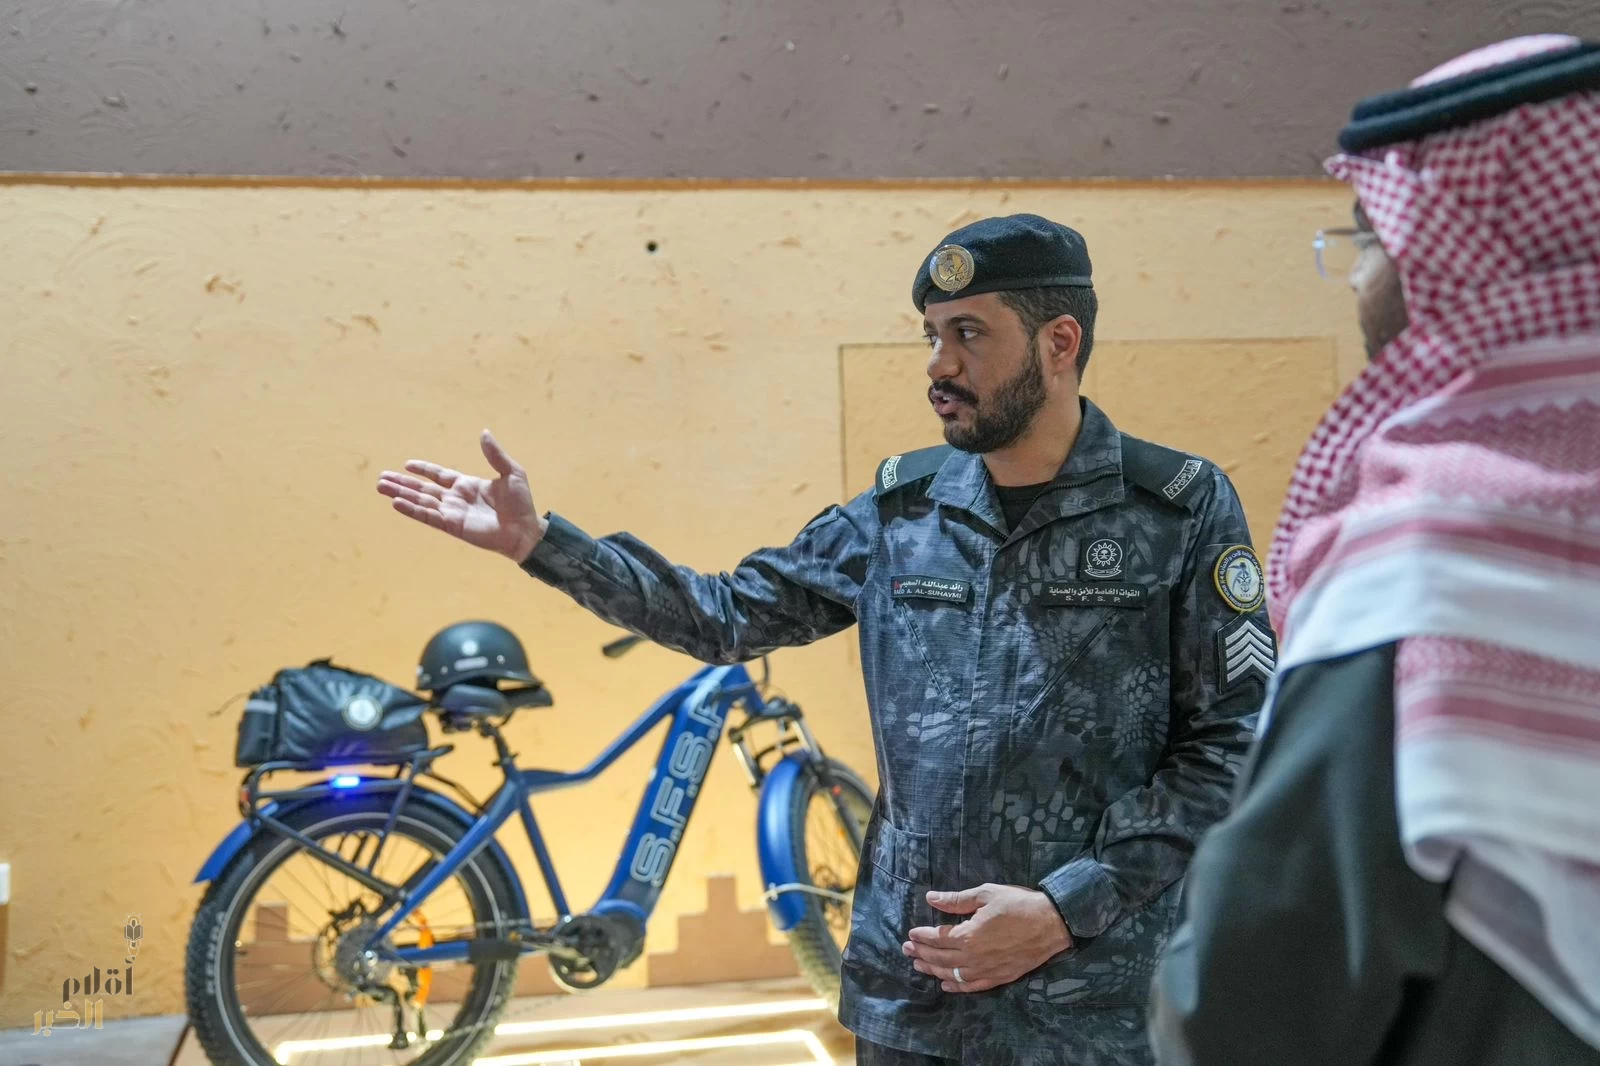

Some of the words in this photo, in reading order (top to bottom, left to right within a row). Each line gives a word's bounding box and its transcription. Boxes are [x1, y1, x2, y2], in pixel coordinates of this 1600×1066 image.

[921, 581, 948, 590] عبدالله
[915, 588, 962, 599] AL-SUHAYMI
[1049, 587, 1077, 596] والحماية
[1077, 586, 1094, 596] للأمن
[1095, 587, 1118, 595] الخاصة
[1119, 588, 1140, 598] القوات
